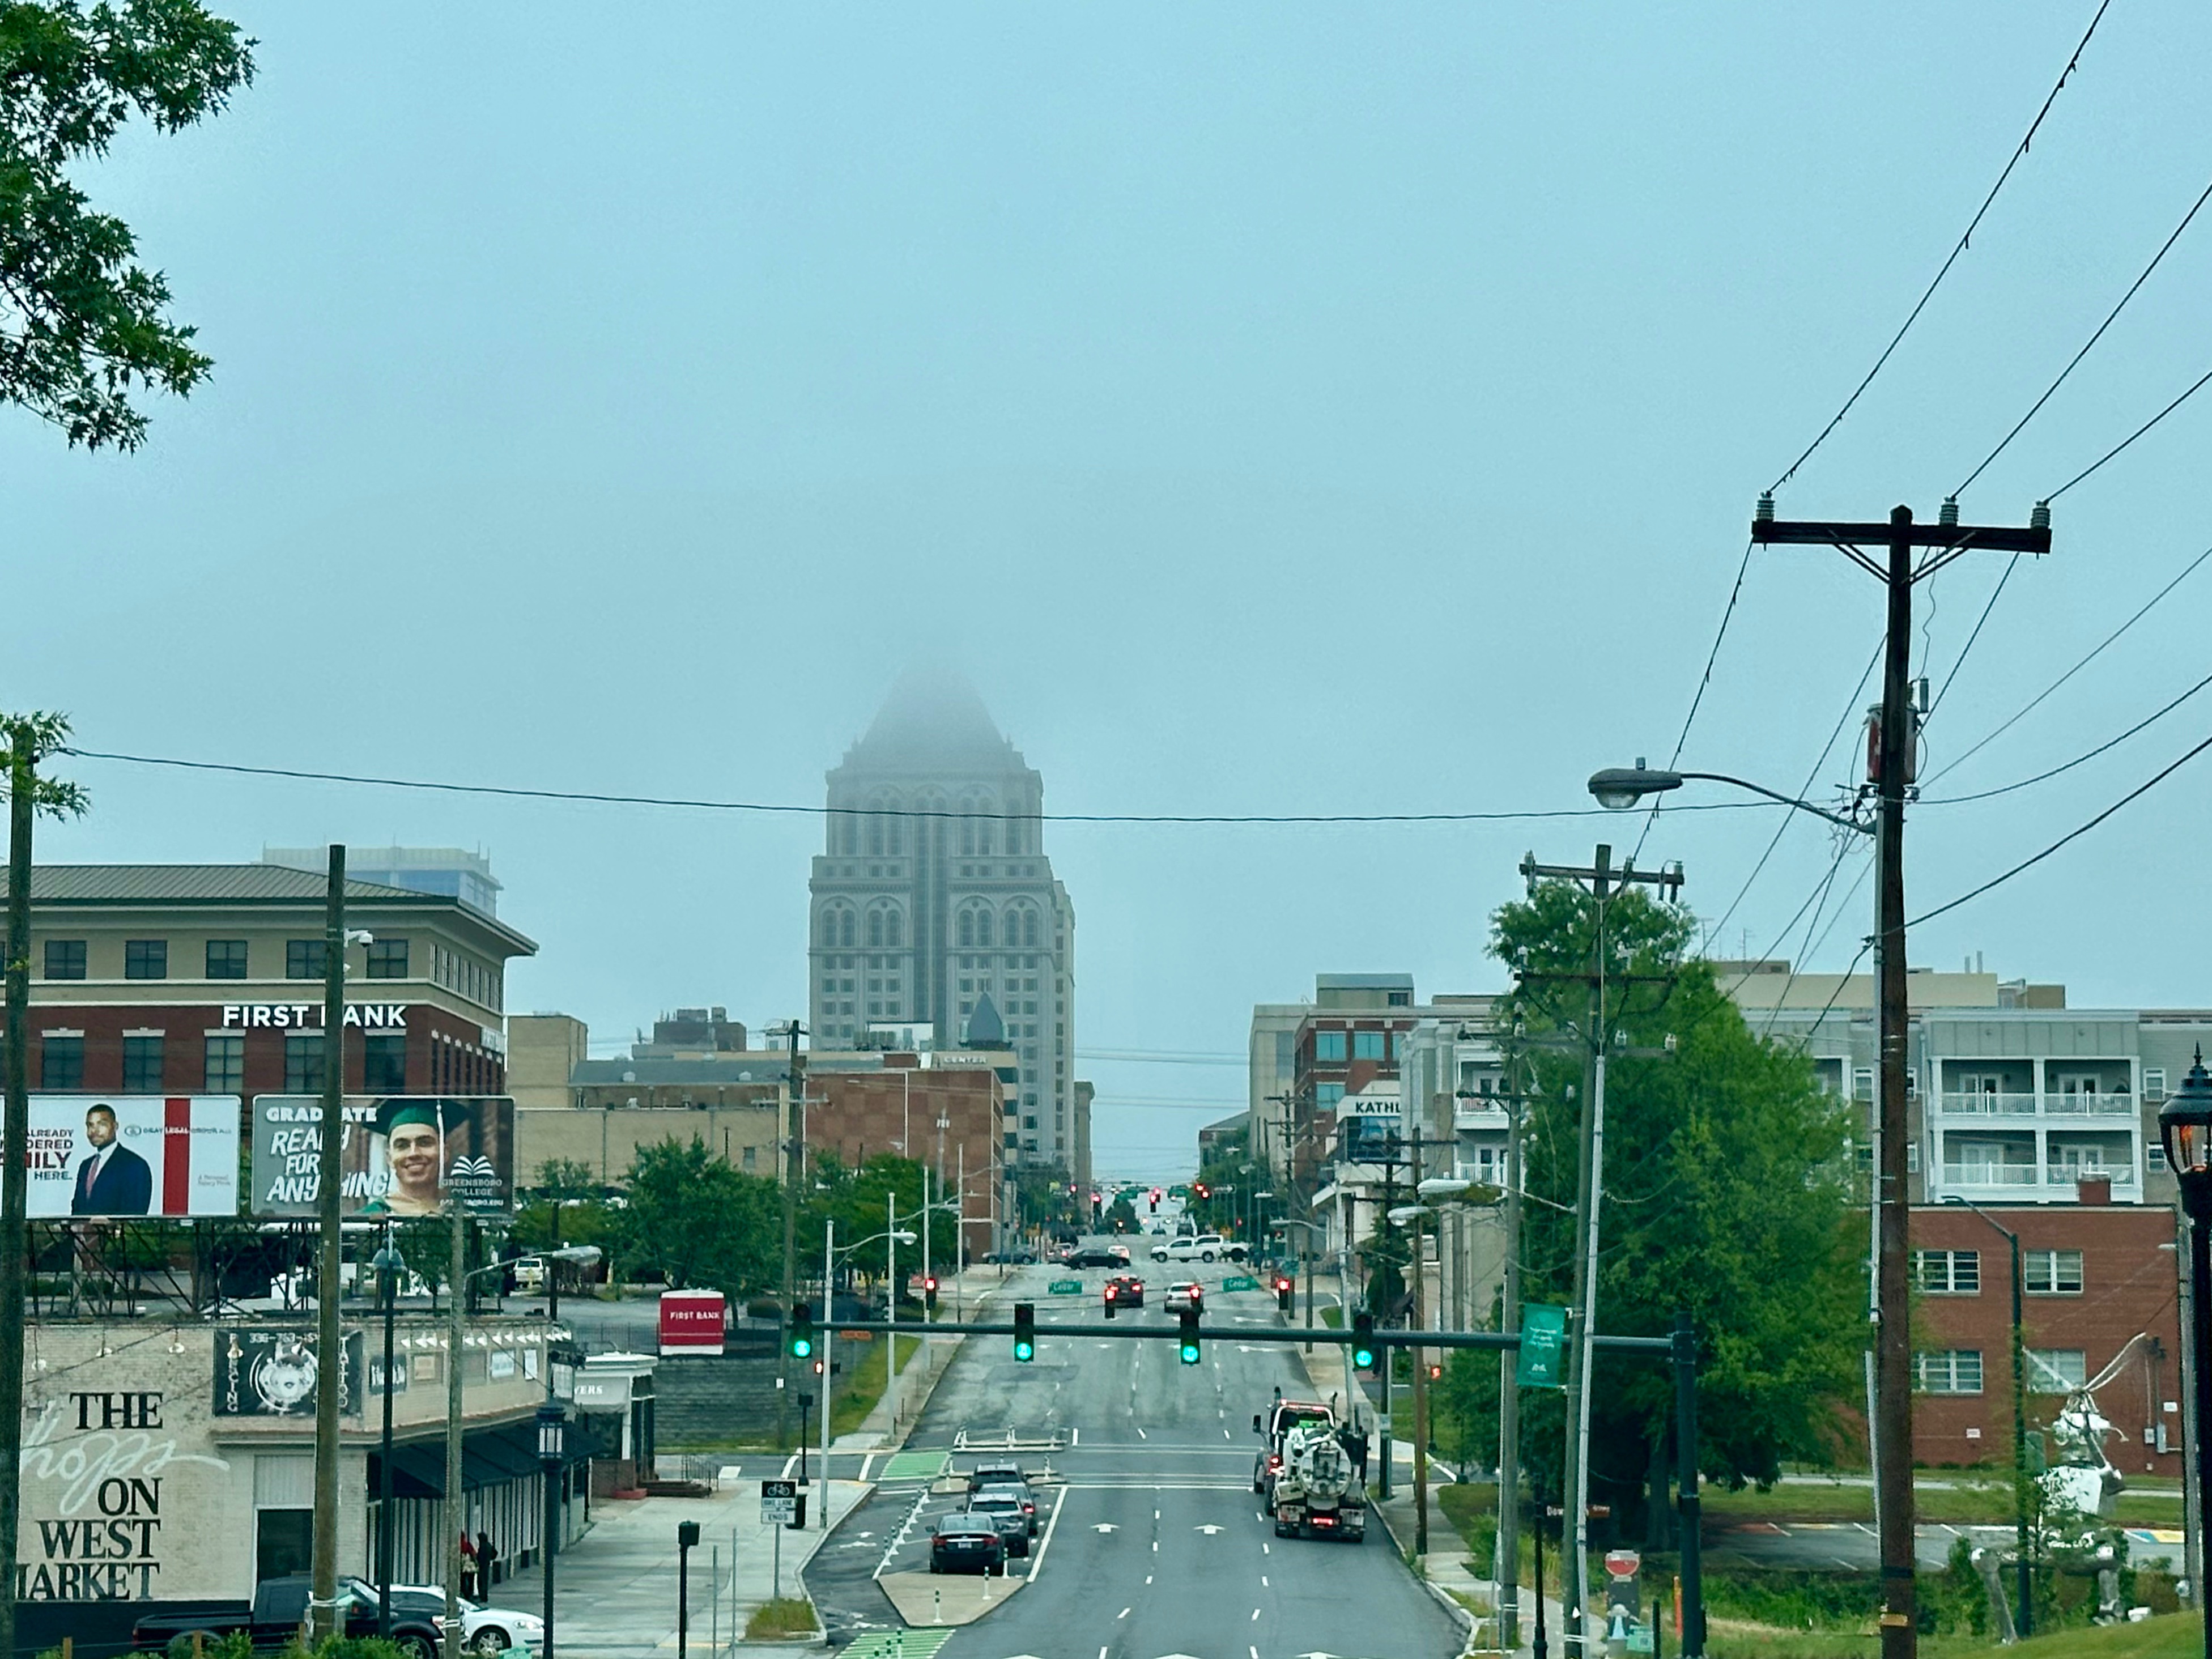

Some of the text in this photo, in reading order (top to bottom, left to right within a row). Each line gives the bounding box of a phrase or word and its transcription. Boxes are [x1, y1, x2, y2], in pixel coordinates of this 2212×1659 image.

[223, 1005, 406, 1027] FIRST ANK
[266, 1107, 377, 1122] GRADATE
[286, 1153, 321, 1177] FOR
[266, 1171, 389, 1203] ANYHING
[670, 1311, 694, 1320] FIRST
[69, 1392, 163, 1430] THE
[20, 1400, 231, 1515] hops
[97, 1477, 163, 1516] ON
[36, 1518, 161, 1559] WEST
